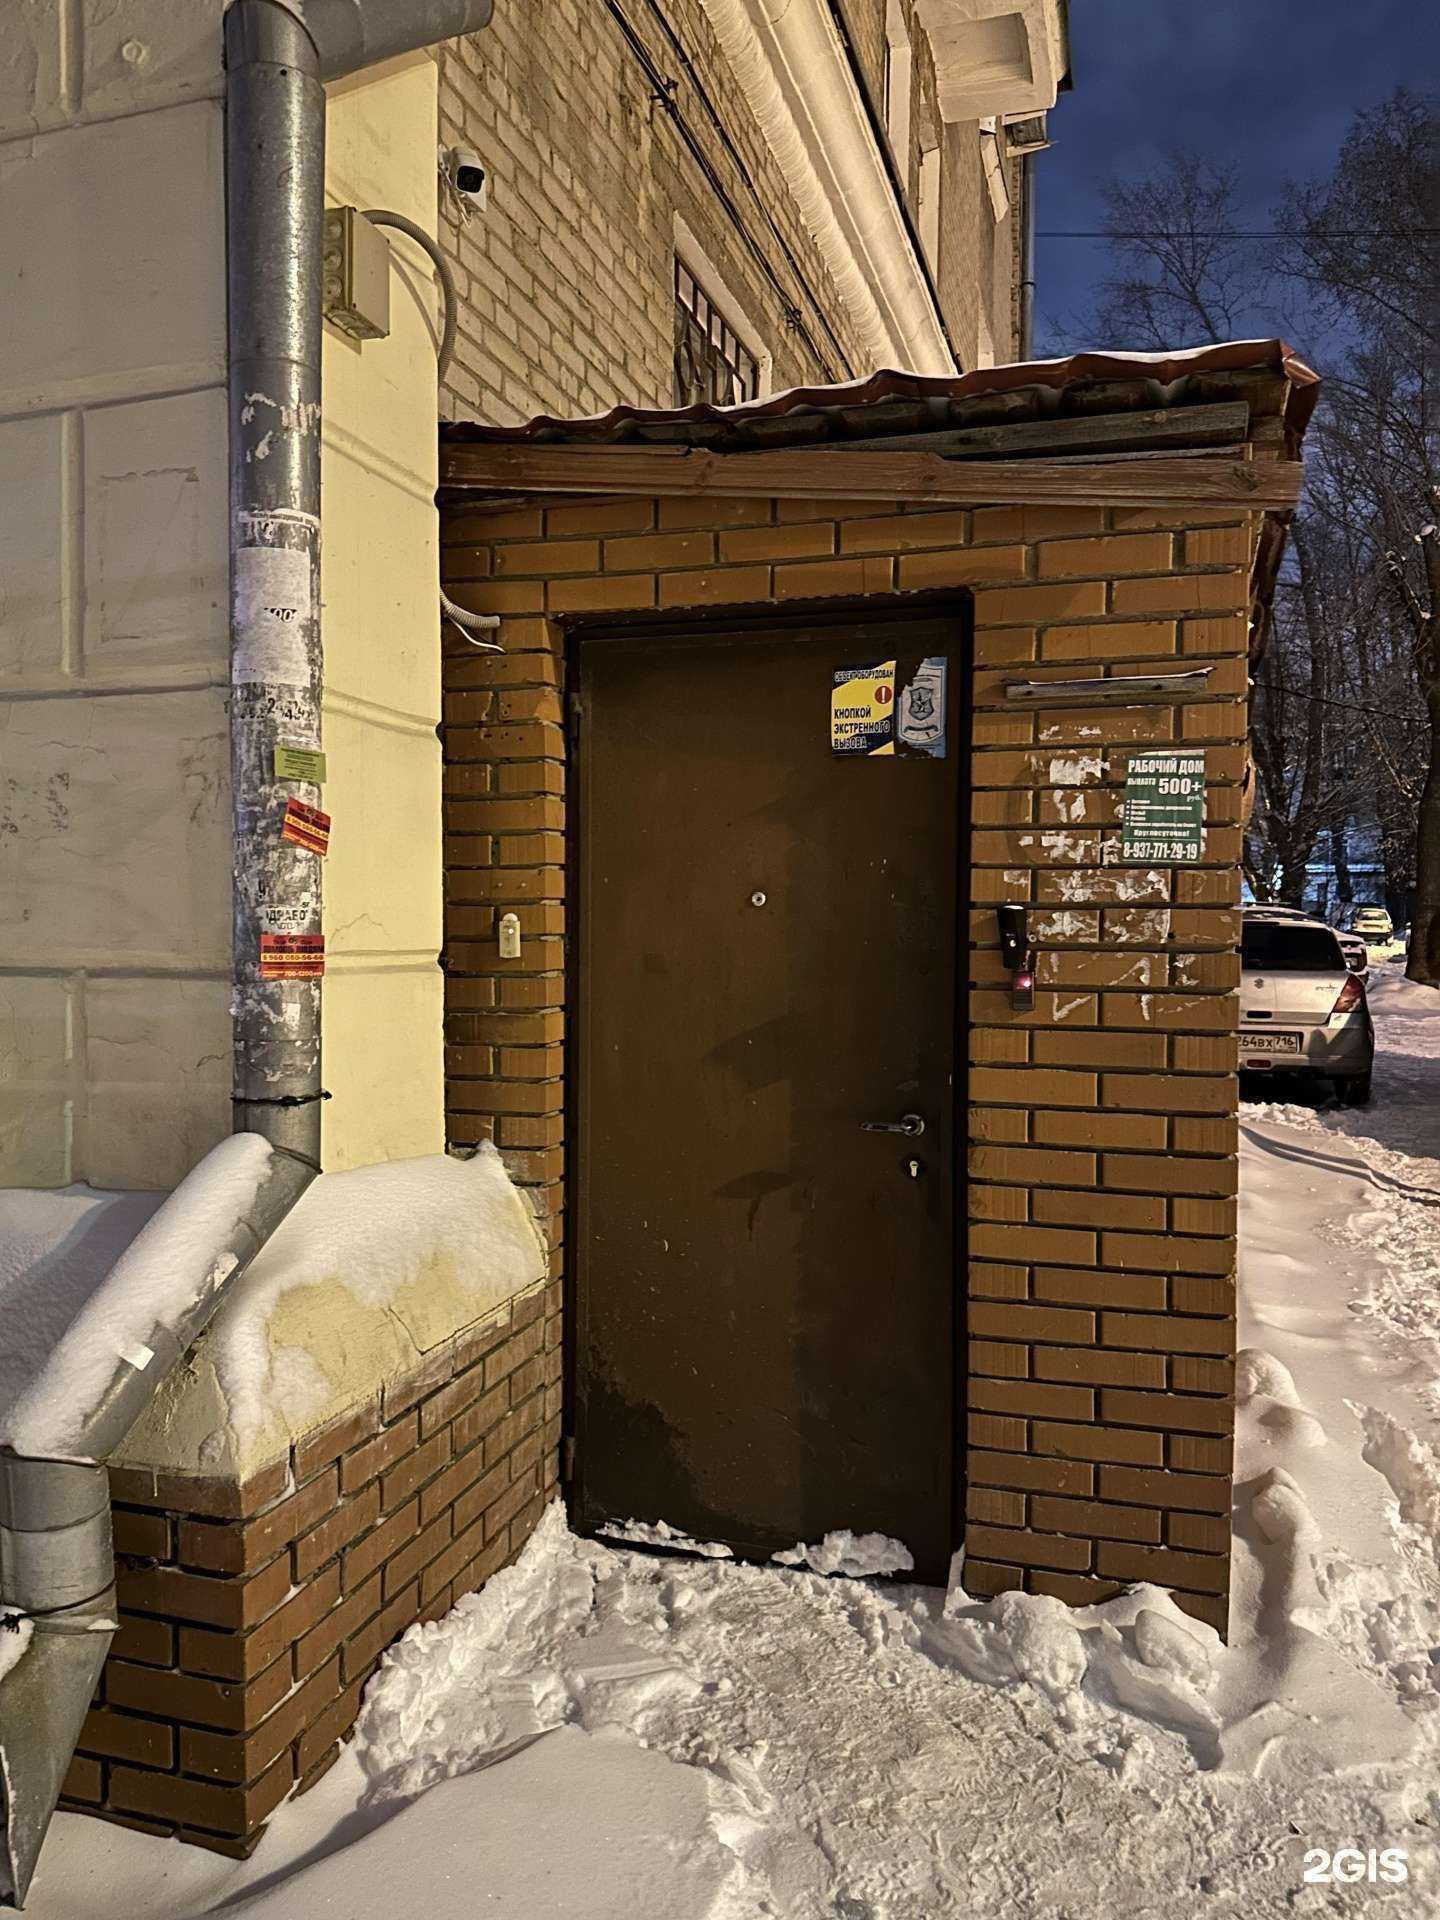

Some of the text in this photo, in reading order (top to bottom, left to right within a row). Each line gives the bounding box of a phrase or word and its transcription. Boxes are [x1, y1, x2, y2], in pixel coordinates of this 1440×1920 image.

[834, 705, 872, 719] КНОПКОЙ
[834, 720, 891, 734] ЭКСТРЕННОГО
[833, 736, 868, 749] ВЫЗОВА
[1128, 758, 1205, 775] РАБОЧИЙ ДОМ
[1158, 777, 1202, 795] 500+
[1123, 841, 1198, 860] 8-937-771-29-19
[1275, 1036, 1295, 1046] 716
